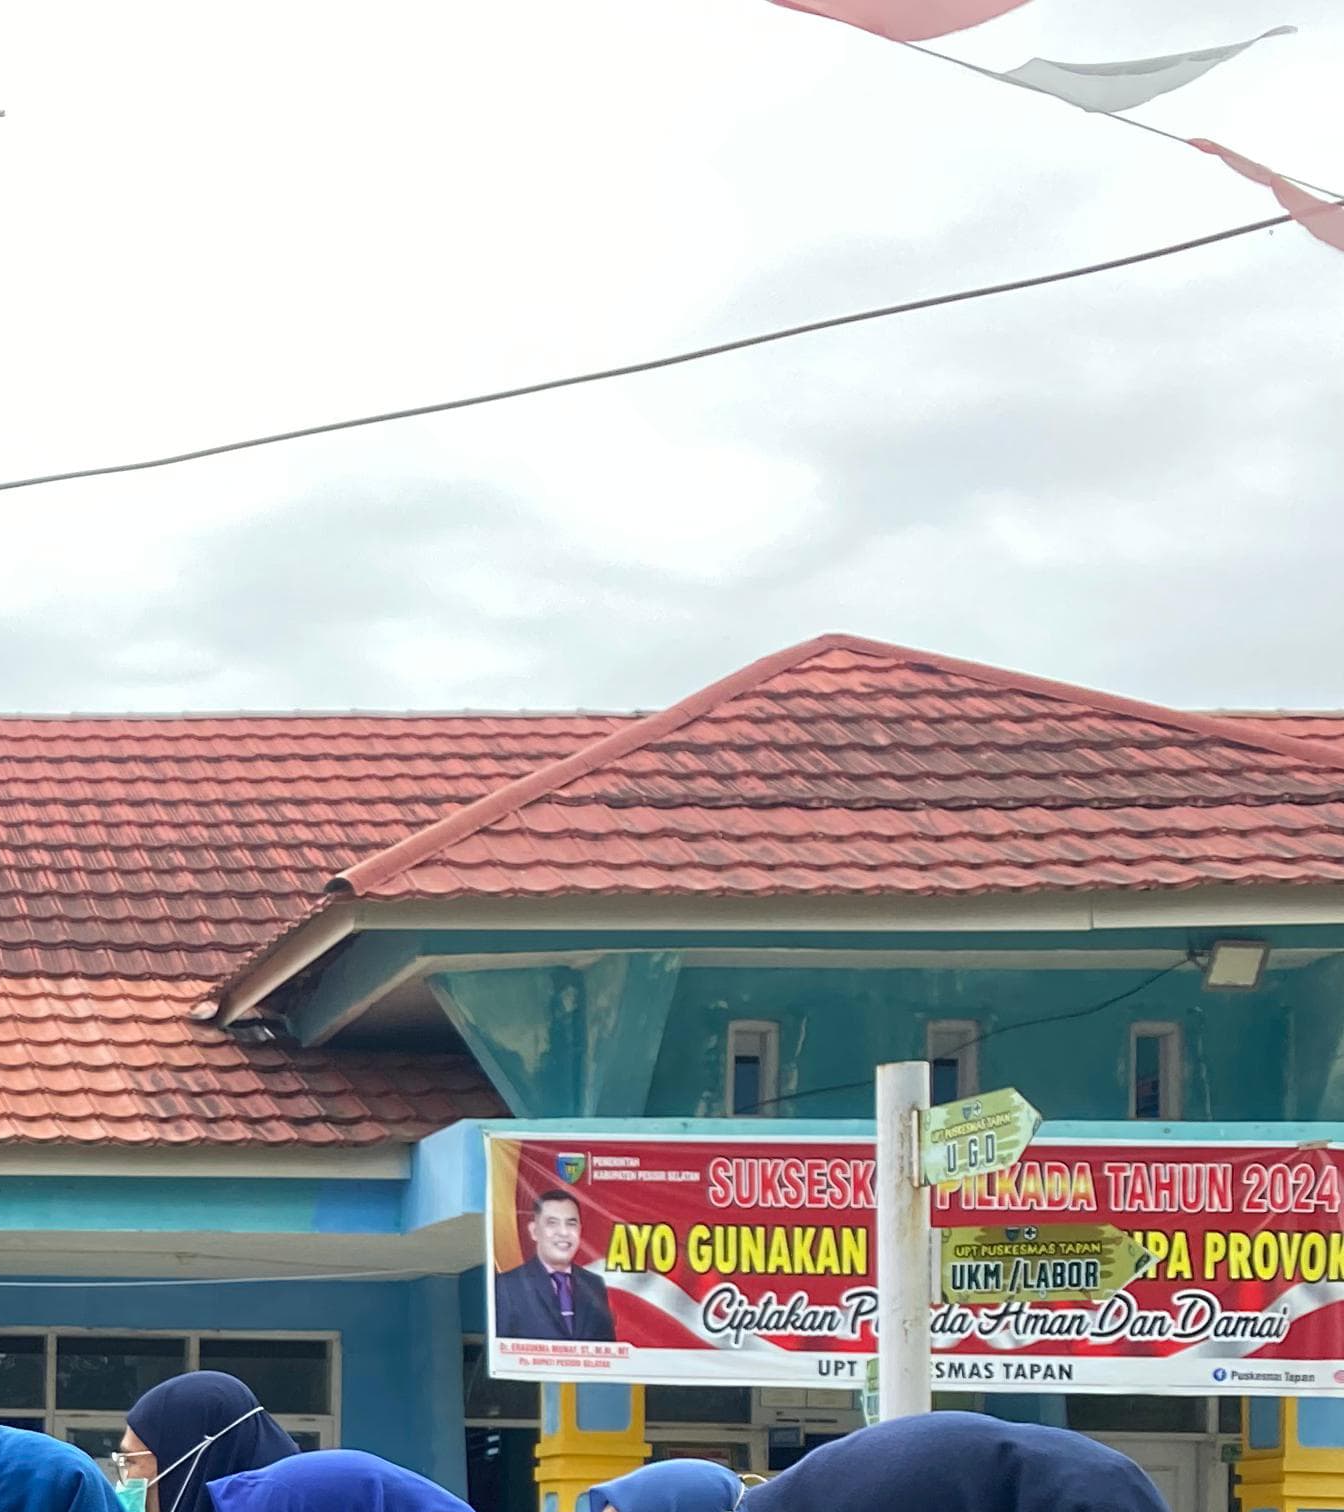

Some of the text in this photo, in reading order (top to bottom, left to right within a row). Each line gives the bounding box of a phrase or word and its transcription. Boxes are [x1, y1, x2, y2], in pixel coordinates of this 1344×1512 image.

[709, 1157, 1340, 1214] SUKSESK PILKADA TAHUN 2024
[605, 1221, 678, 1275] AYO
[688, 1224, 868, 1276] GUNAKAN
[955, 1240, 1101, 1258] UPT PUSKESMAS TAPAN
[951, 1261, 1001, 1291] UKM
[702, 1286, 839, 1337] Ciptakan
[978, 1302, 1090, 1337] Aman
[1091, 1292, 1173, 1338] Dan
[1173, 1292, 1289, 1339] Damai
[817, 1359, 857, 1377] UPT
[1003, 1363, 1073, 1380] TAPAN
[1285, 1371, 1315, 1383] Tapan
